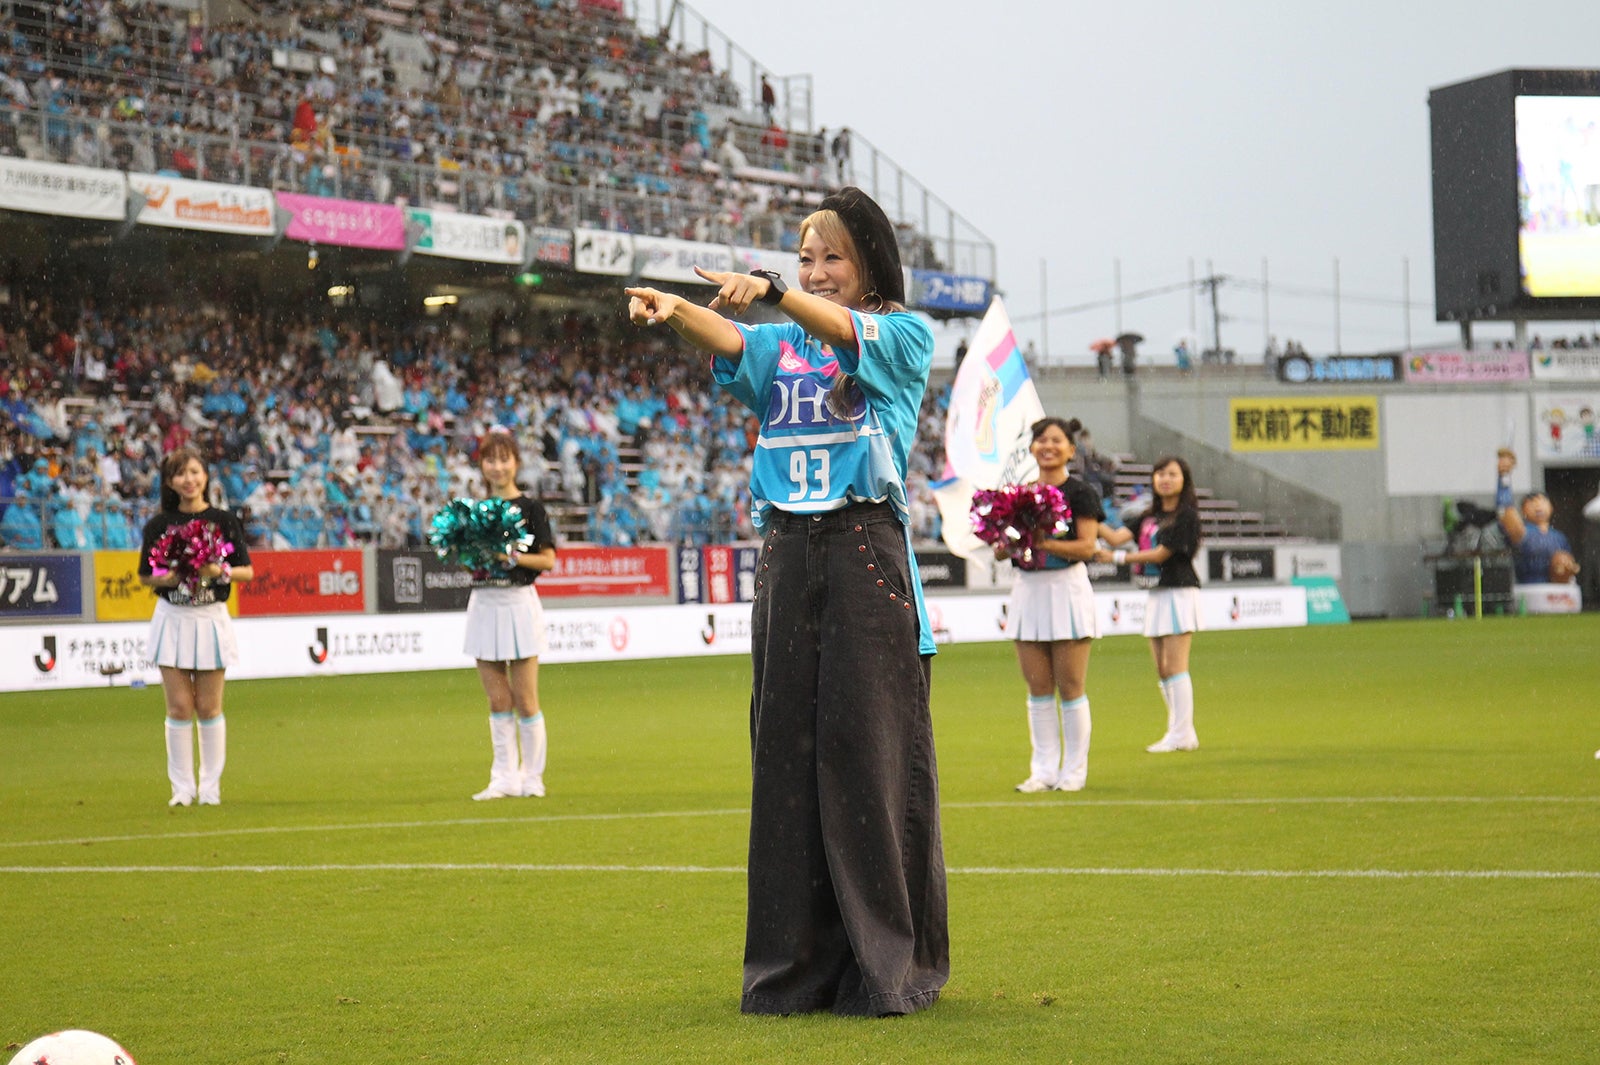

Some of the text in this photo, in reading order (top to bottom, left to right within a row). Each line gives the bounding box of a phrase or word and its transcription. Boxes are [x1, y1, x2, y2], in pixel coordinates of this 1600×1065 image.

[1236, 406, 1374, 442] 駅前不動産
[788, 449, 830, 502] 93
[318, 559, 360, 596] BIG
